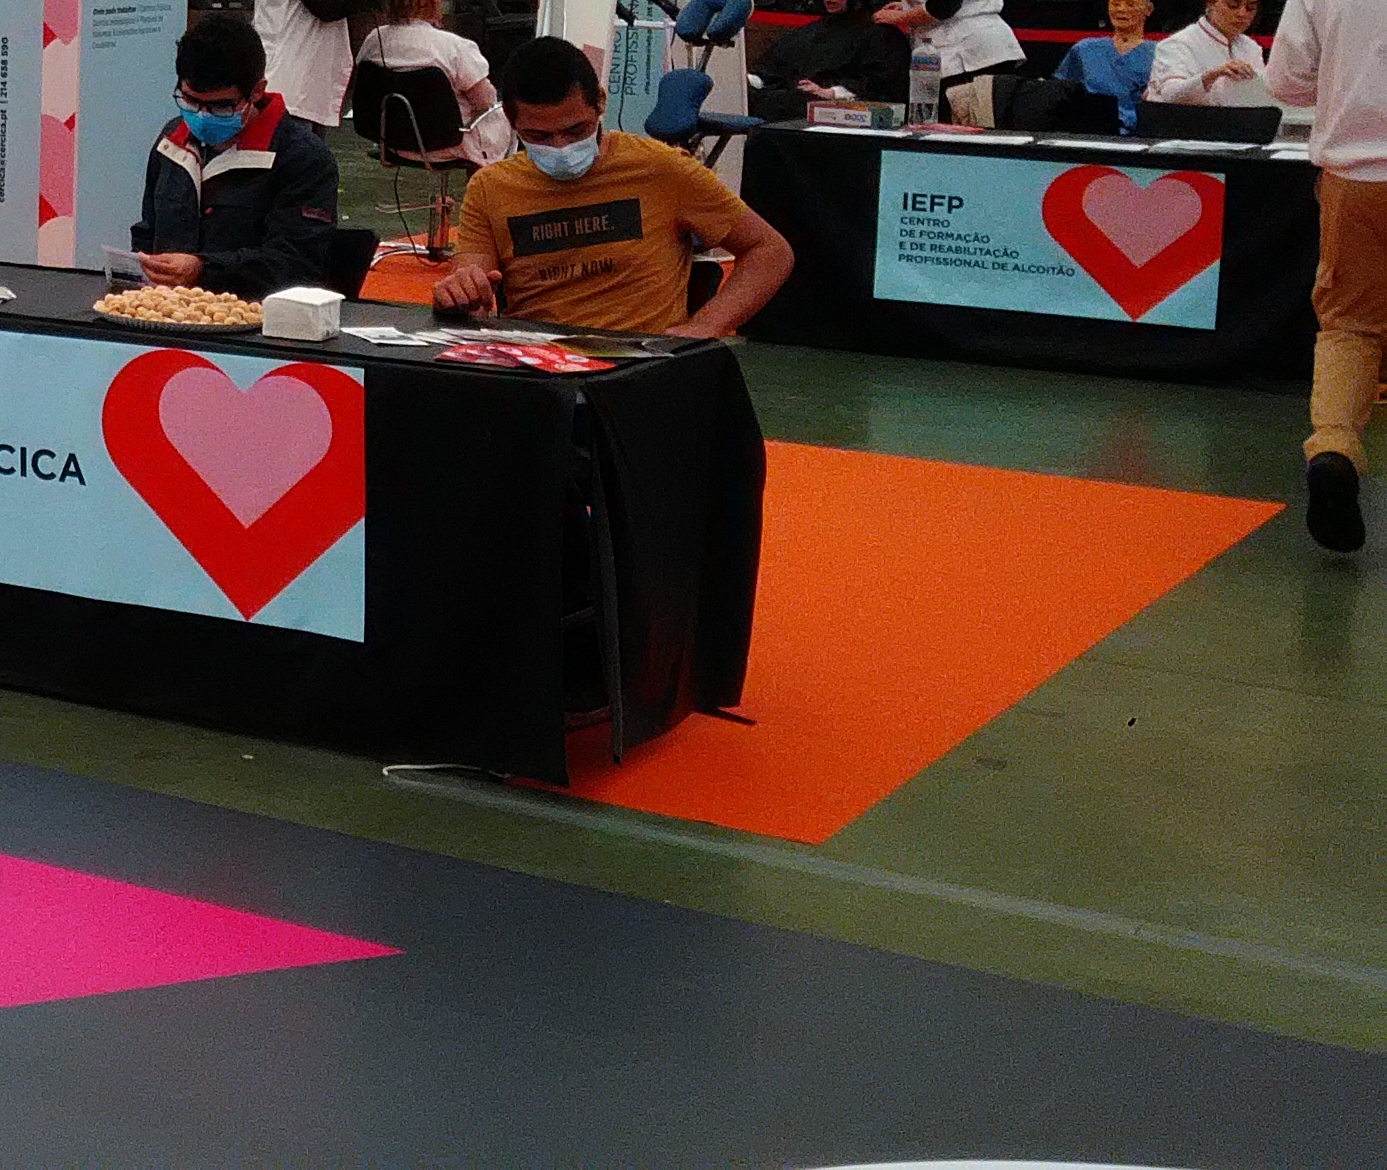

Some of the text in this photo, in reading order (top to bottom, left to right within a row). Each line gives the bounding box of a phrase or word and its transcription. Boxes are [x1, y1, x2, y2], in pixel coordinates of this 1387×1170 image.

[607, 30, 623, 95] CENTRO
[0, 80, 8, 100] 214
[902, 191, 964, 214] IEFP
[531, 214, 615, 242] RIGHT HERE.
[900, 216, 951, 229] CENTRO
[899, 229, 991, 245] DE FORMAÇÃO
[899, 241, 1020, 259] E DE REABILITAÇÃO
[898, 253, 1075, 277] PROFISSIONAL DE ALCOITÃO
